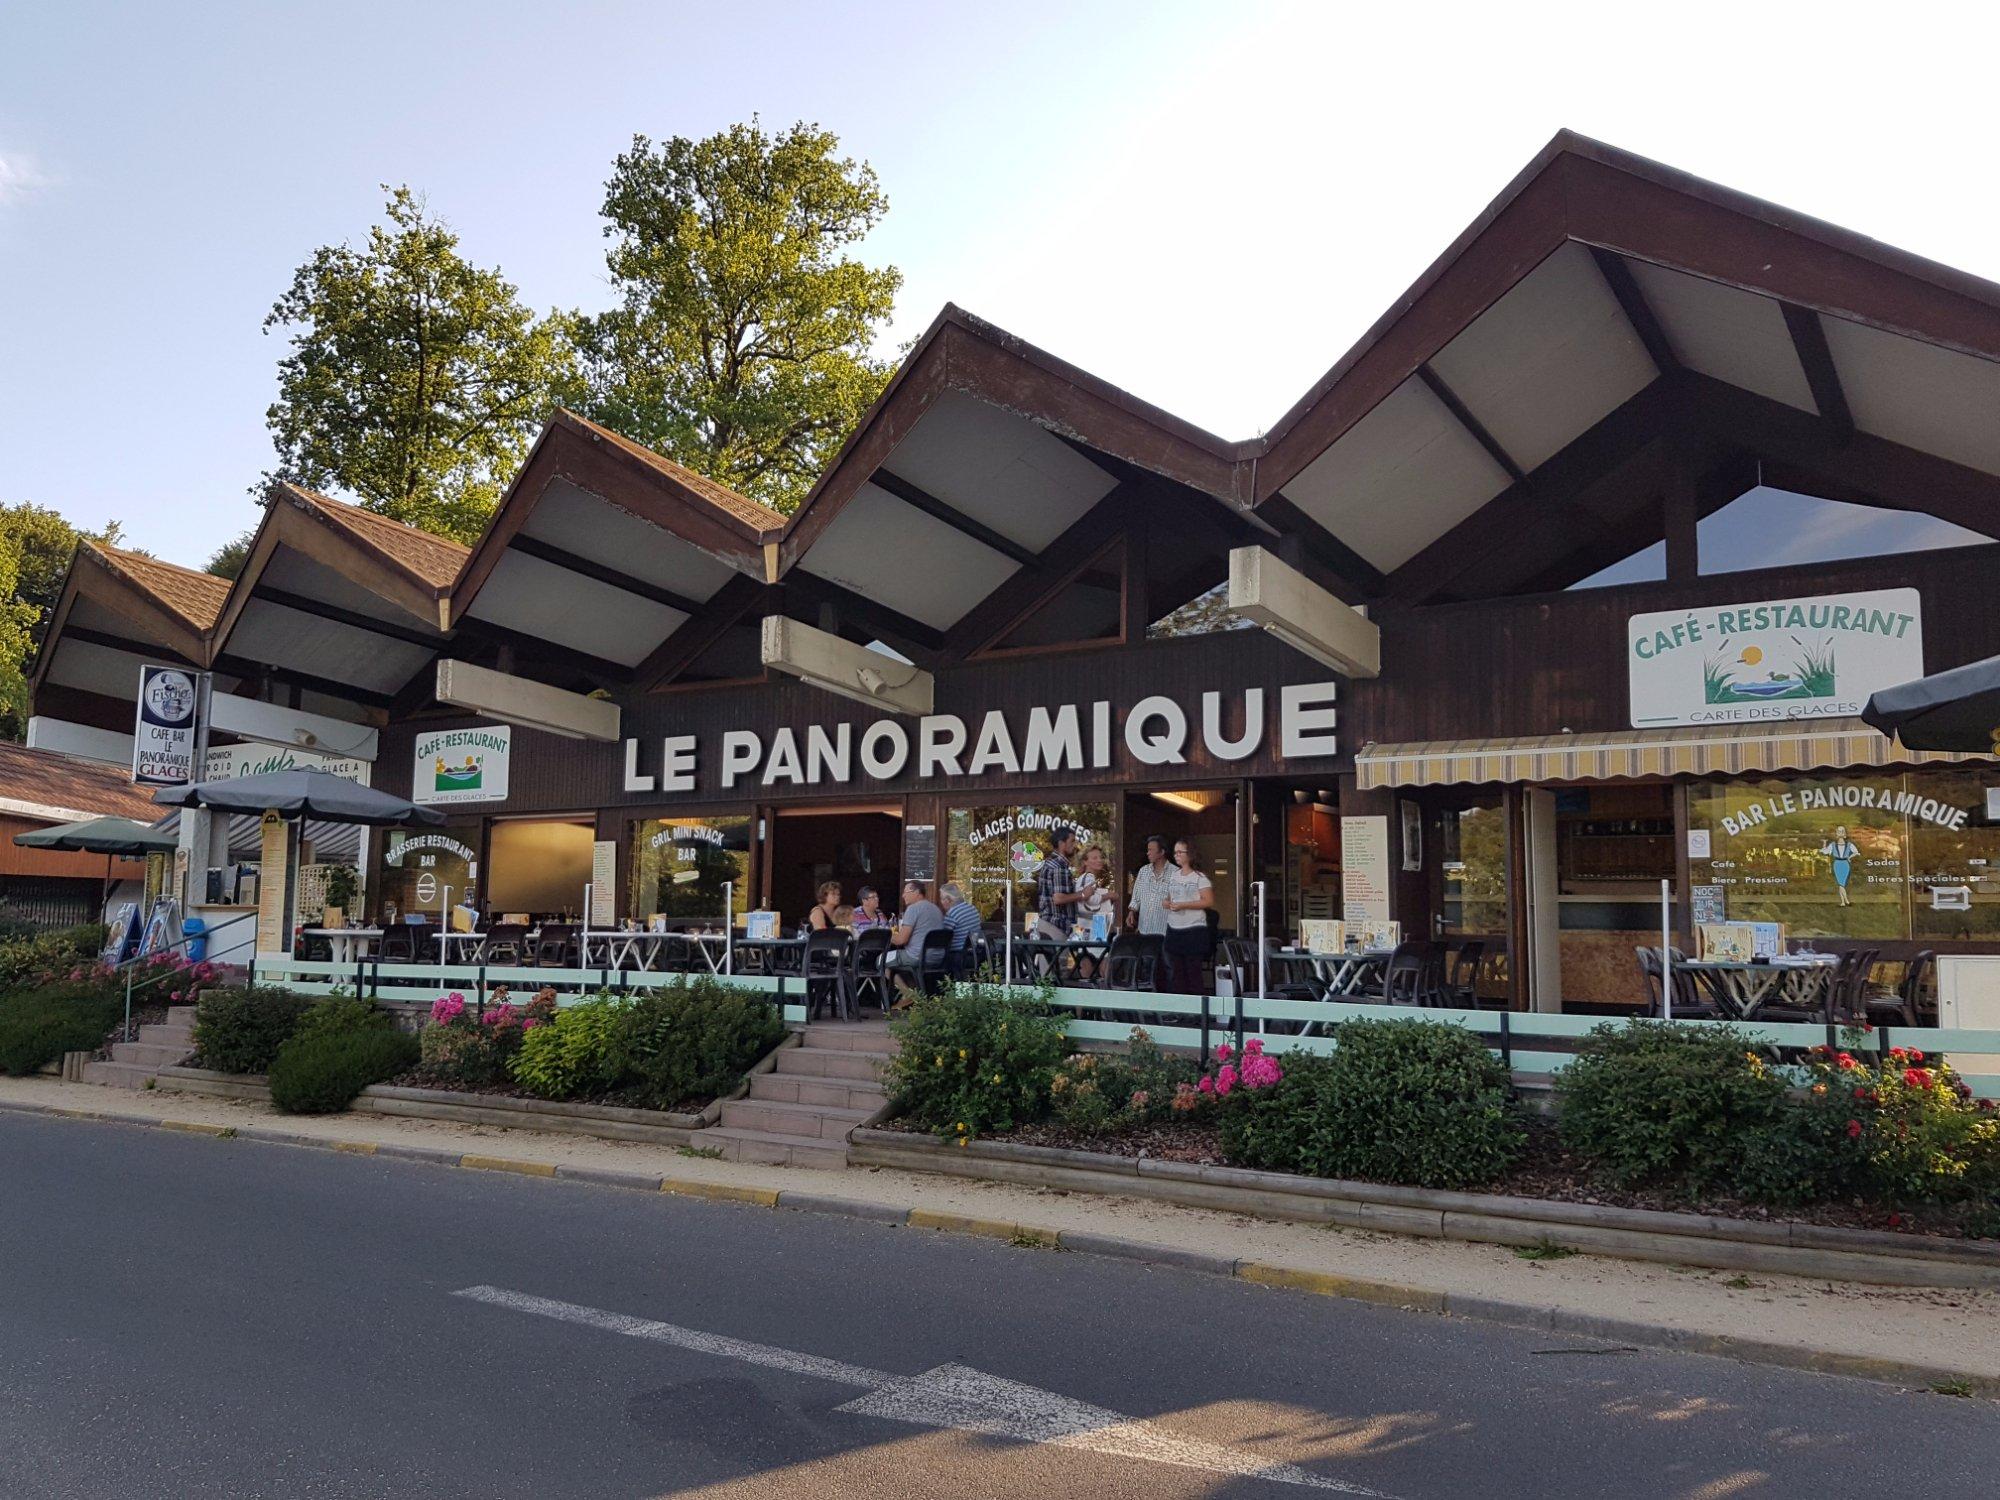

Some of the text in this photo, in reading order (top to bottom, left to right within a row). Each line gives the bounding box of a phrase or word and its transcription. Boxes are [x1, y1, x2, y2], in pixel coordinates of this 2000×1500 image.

[1635, 604, 1914, 659] CAFÉ-RESTAURANT
[1689, 702, 1858, 722] CARTE DES GLACES
[151, 727, 185, 742] CAFE BAR
[624, 681, 1337, 792] LE PANORAMIQUE
[164, 741, 173, 752] LE
[418, 732, 507, 759] CAFÉ-RESTAURANT
[140, 751, 190, 767] PANORAMIQUE
[139, 763, 188, 779] GLACES
[322, 763, 349, 773] GLACE
[1720, 803, 1767, 837] BAR
[1768, 793, 1797, 818] LE
[1800, 786, 1969, 832] PANORAMIQUE
[651, 826, 725, 848] GRIL MINI SNACK
[969, 816, 1014, 846] GLACES
[385, 834, 474, 863] BRASSERIE RESTAURANT
[678, 847, 696, 860] BAR
[420, 855, 436, 866] BAR
[1744, 876, 1788, 884] Pression
[1693, 887, 1714, 896] NOC
